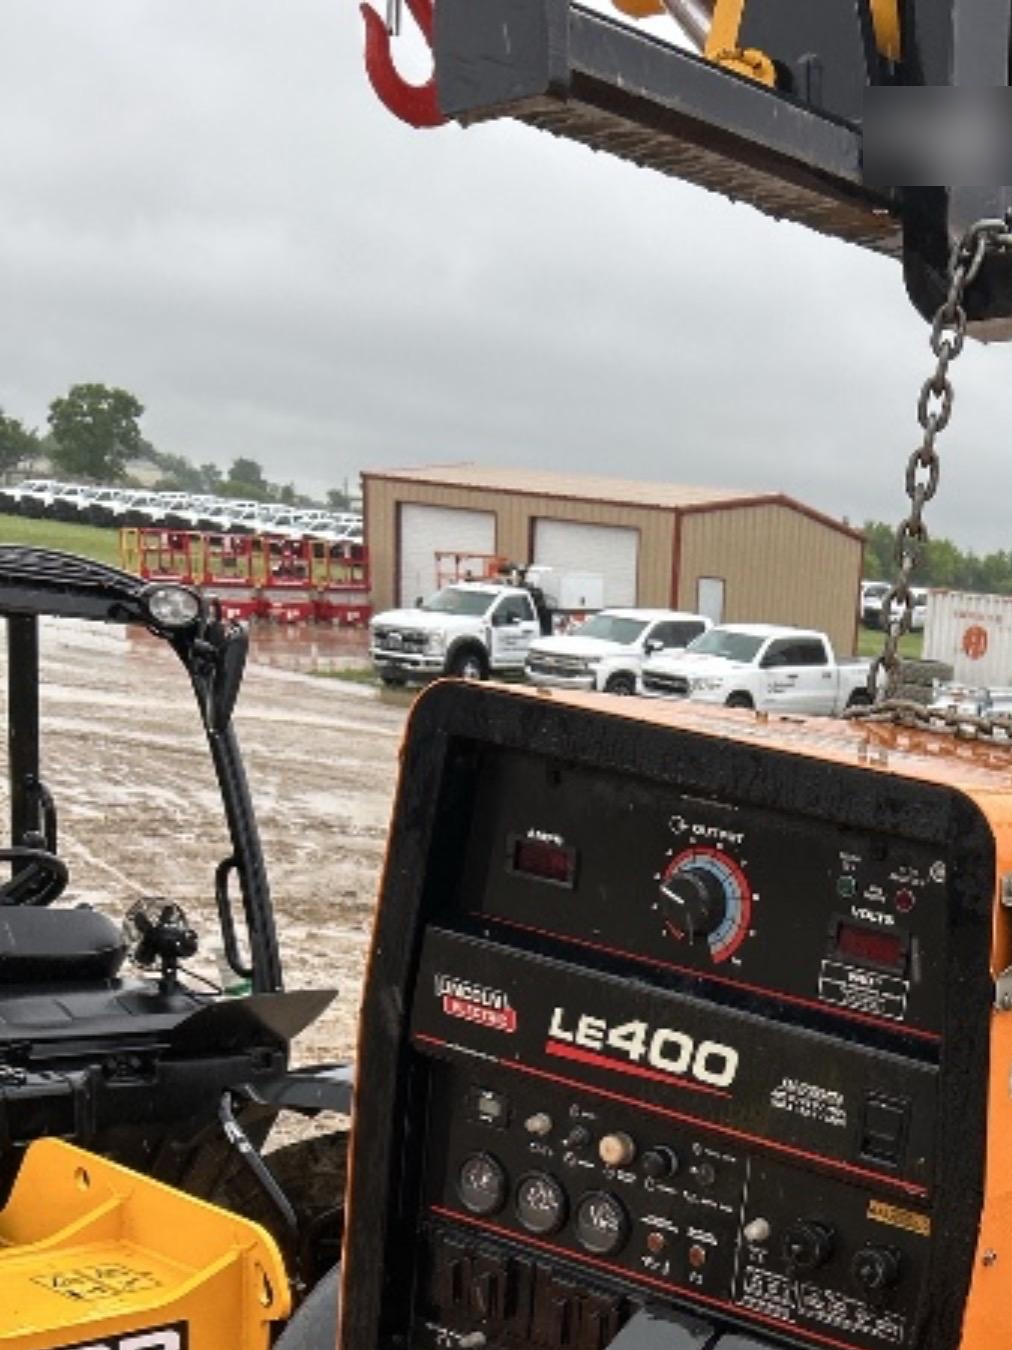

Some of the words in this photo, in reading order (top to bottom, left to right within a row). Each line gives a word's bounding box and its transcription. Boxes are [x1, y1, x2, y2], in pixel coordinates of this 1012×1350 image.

[692, 823, 745, 845] OUTPUT
[851, 905, 896, 926] VOLTS
[548, 1007, 740, 1088] LE400
